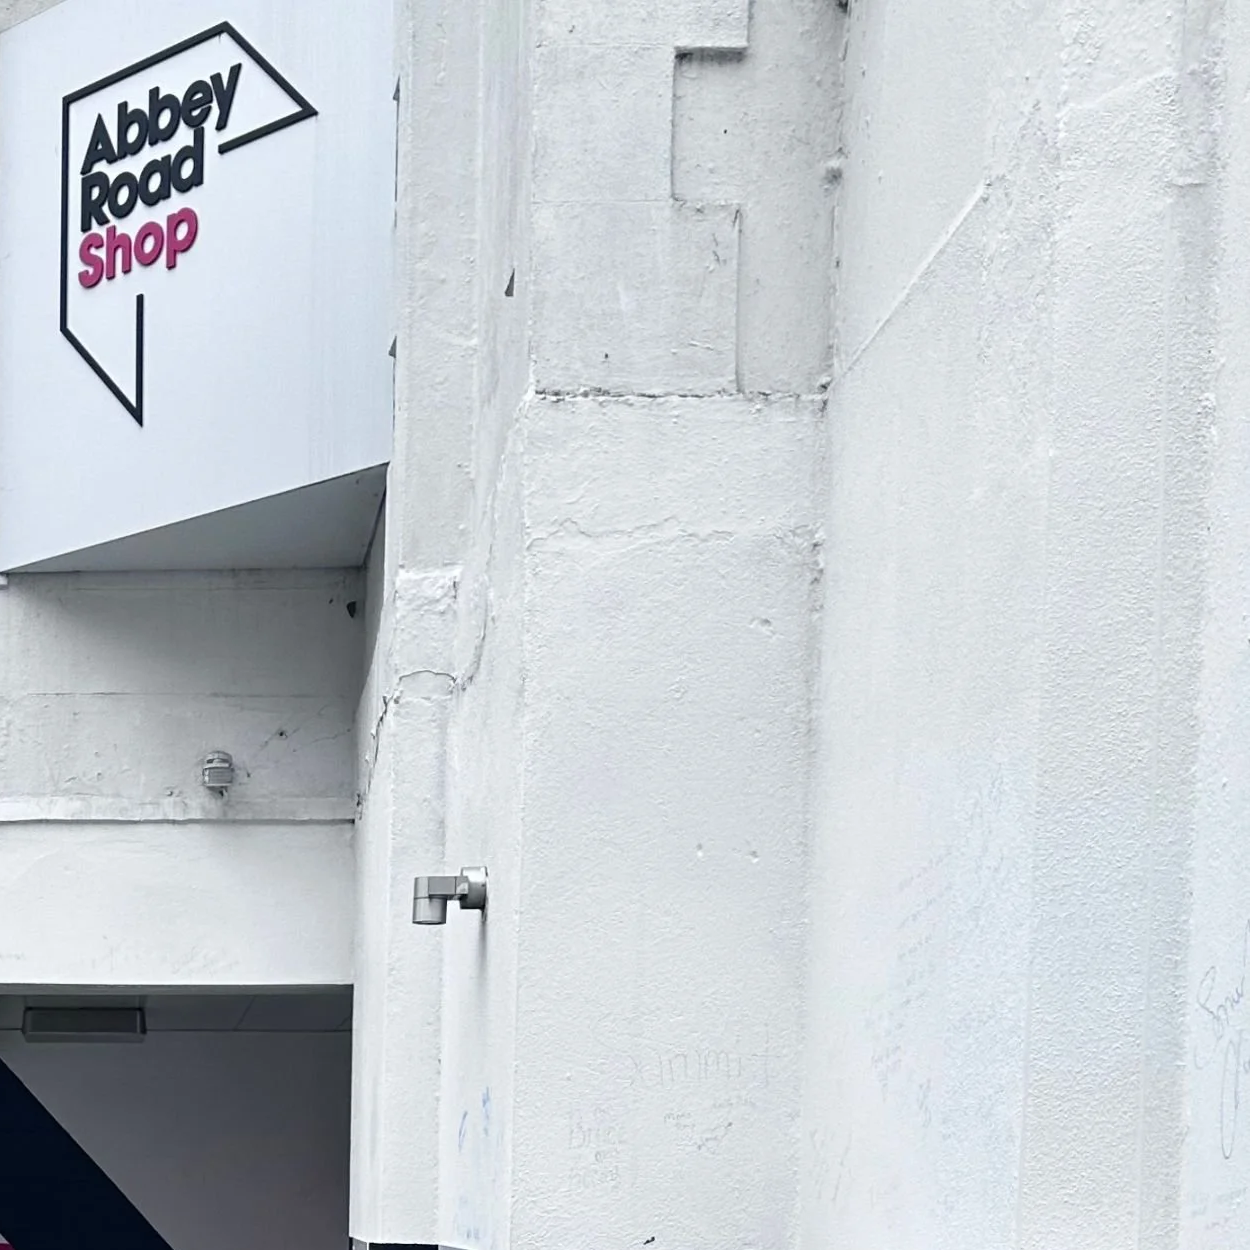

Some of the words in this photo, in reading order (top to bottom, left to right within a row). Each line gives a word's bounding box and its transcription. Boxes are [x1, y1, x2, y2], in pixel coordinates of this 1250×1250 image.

[80, 63, 242, 175] Abbey
[81, 126, 205, 232] Road
[78, 207, 198, 288] Shop
